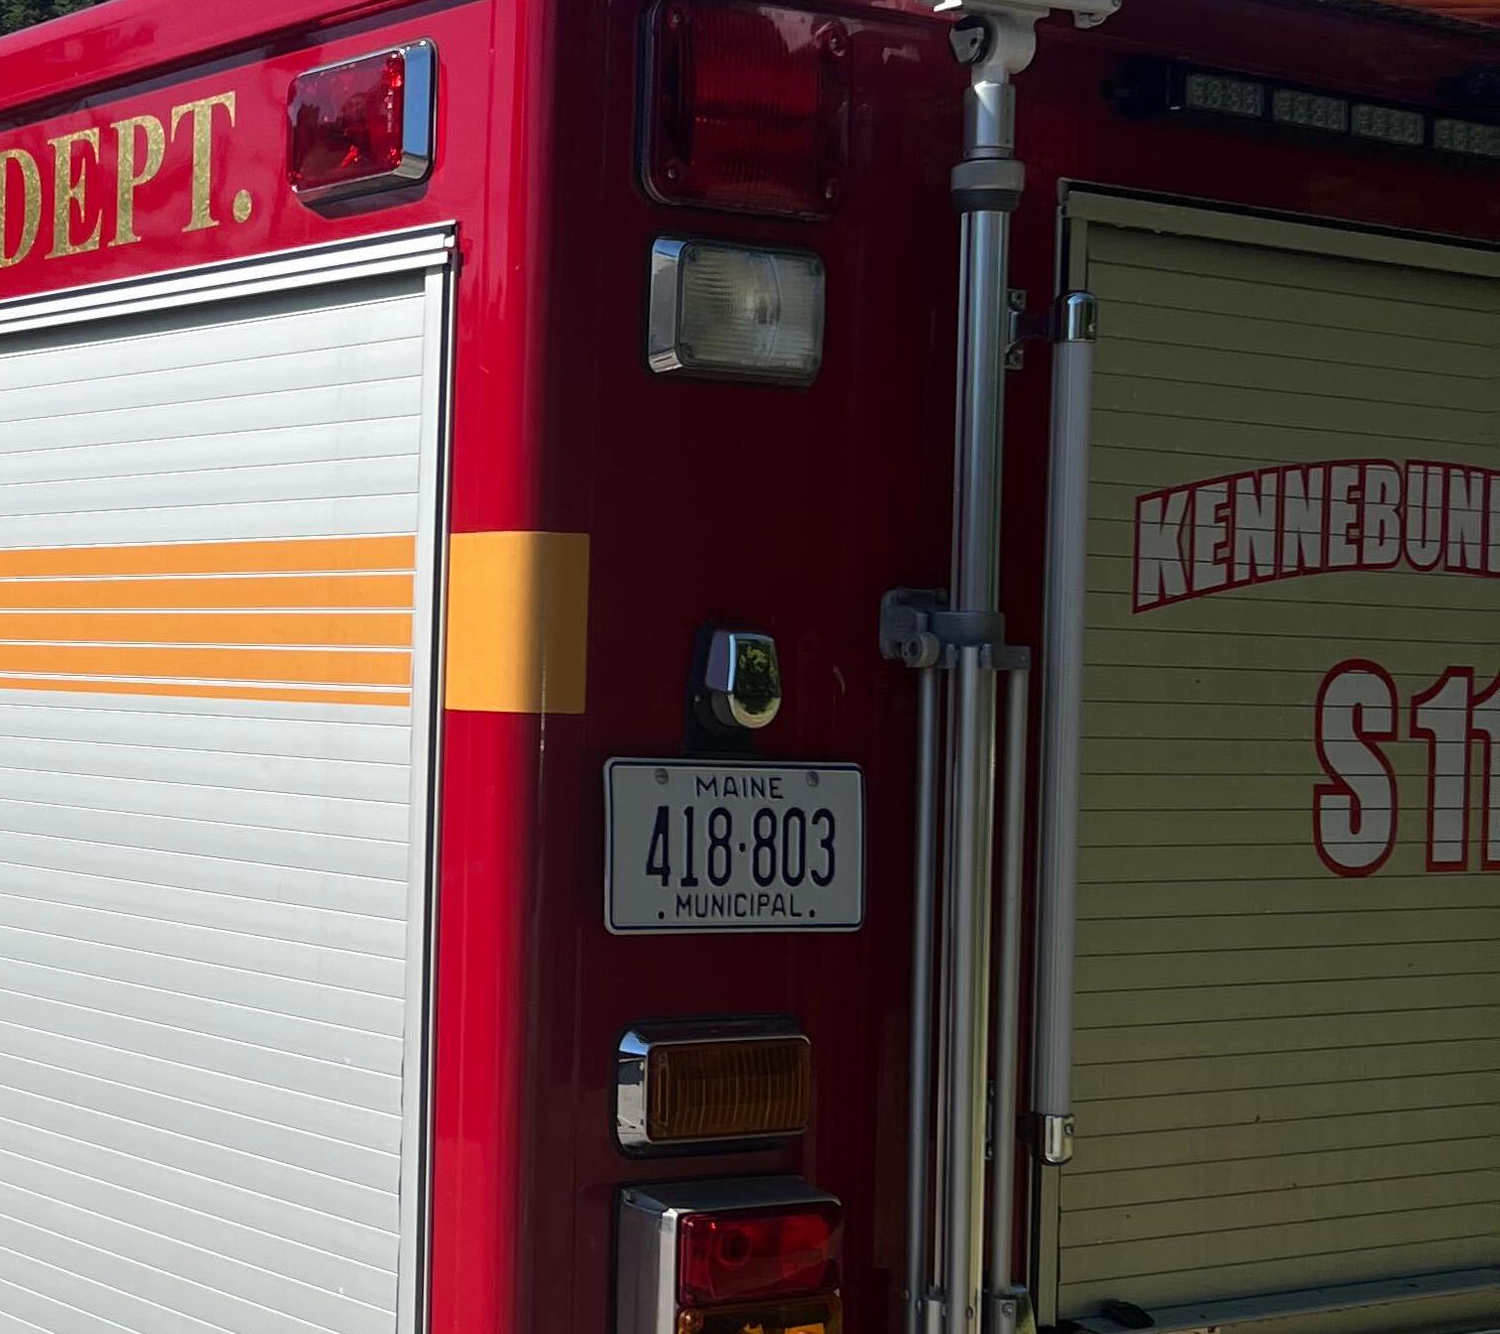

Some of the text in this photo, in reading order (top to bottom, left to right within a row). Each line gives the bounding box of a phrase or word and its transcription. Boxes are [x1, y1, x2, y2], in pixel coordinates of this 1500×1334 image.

[1132, 458, 1500, 614] KENNEBUN
[695, 776, 784, 799] MAINE
[675, 893, 802, 918] MUNICIPAL
